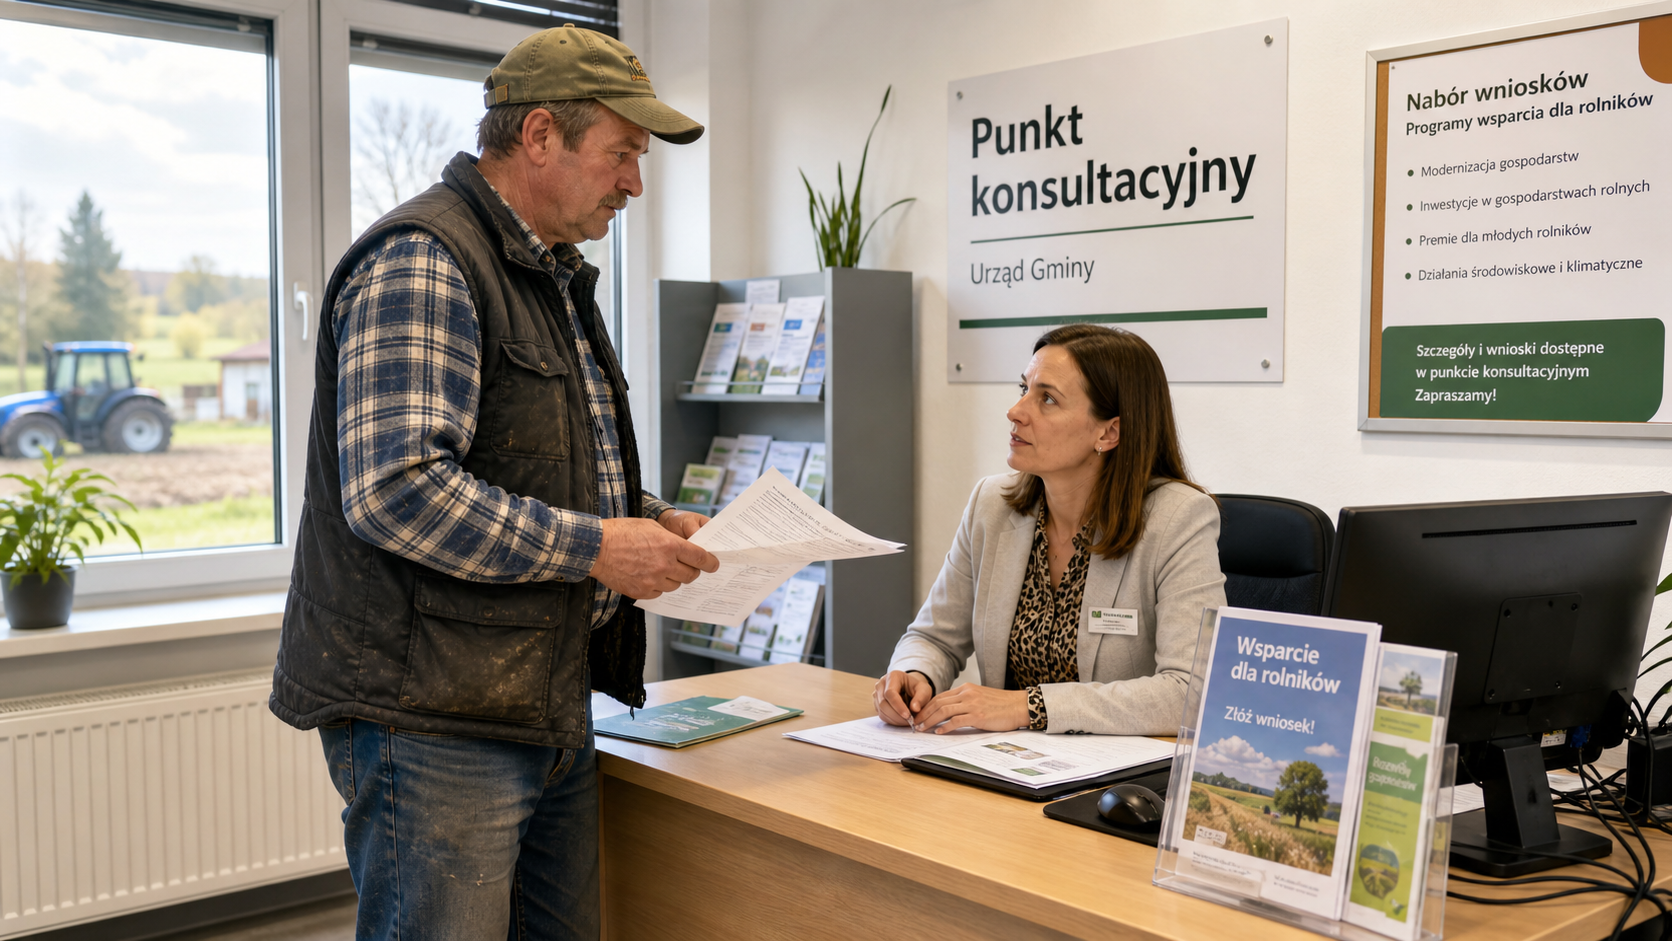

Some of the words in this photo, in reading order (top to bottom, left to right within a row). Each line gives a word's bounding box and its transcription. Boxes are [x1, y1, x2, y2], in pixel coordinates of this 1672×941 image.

[1407, 86, 1469, 112] Nabór
[1474, 70, 1589, 102] wniosków
[1406, 117, 1473, 137] Programy
[1477, 105, 1544, 128] wsparcia
[1549, 101, 1574, 118] dla
[1579, 92, 1654, 114] rolników
[972, 103, 1083, 159] Punkt
[1421, 158, 1496, 178] Modernizacja
[1499, 151, 1580, 173] gospodarstw
[972, 146, 1257, 217] konsultacyjny
[1420, 195, 1479, 212] Inwestycje
[1481, 197, 1492, 207] w
[1495, 184, 1597, 209] gospodarstwach
[1600, 179, 1650, 197] rolnych
[1419, 232, 1458, 246] Premie
[1461, 231, 1479, 244] dla
[1482, 226, 1533, 243] młodych
[1536, 223, 1592, 238] rolników
[970, 258, 1024, 289] Urząd
[1030, 255, 1095, 284] Gminy
[1418, 267, 1468, 281] Działania
[1471, 263, 1556, 278] środowiskowe
[1559, 261, 1563, 273] i
[1566, 259, 1643, 274] klimatyczne
[1416, 343, 1476, 360] Szczegóły
[1479, 343, 1483, 356] i
[1486, 341, 1536, 356] wnioski
[1540, 341, 1605, 358] dostępne
[1415, 368, 1427, 378] w
[1430, 364, 1480, 382] punkcie
[1482, 363, 1589, 381] konsultacyjnym
[1415, 388, 1497, 405] Zapraszamy!
[1237, 635, 1320, 665] Wsparcie
[1230, 660, 1258, 682] dla
[1261, 666, 1341, 694] rolników
[1223, 705, 1253, 724] Złóż
[1256, 713, 1315, 735] wniosek!
